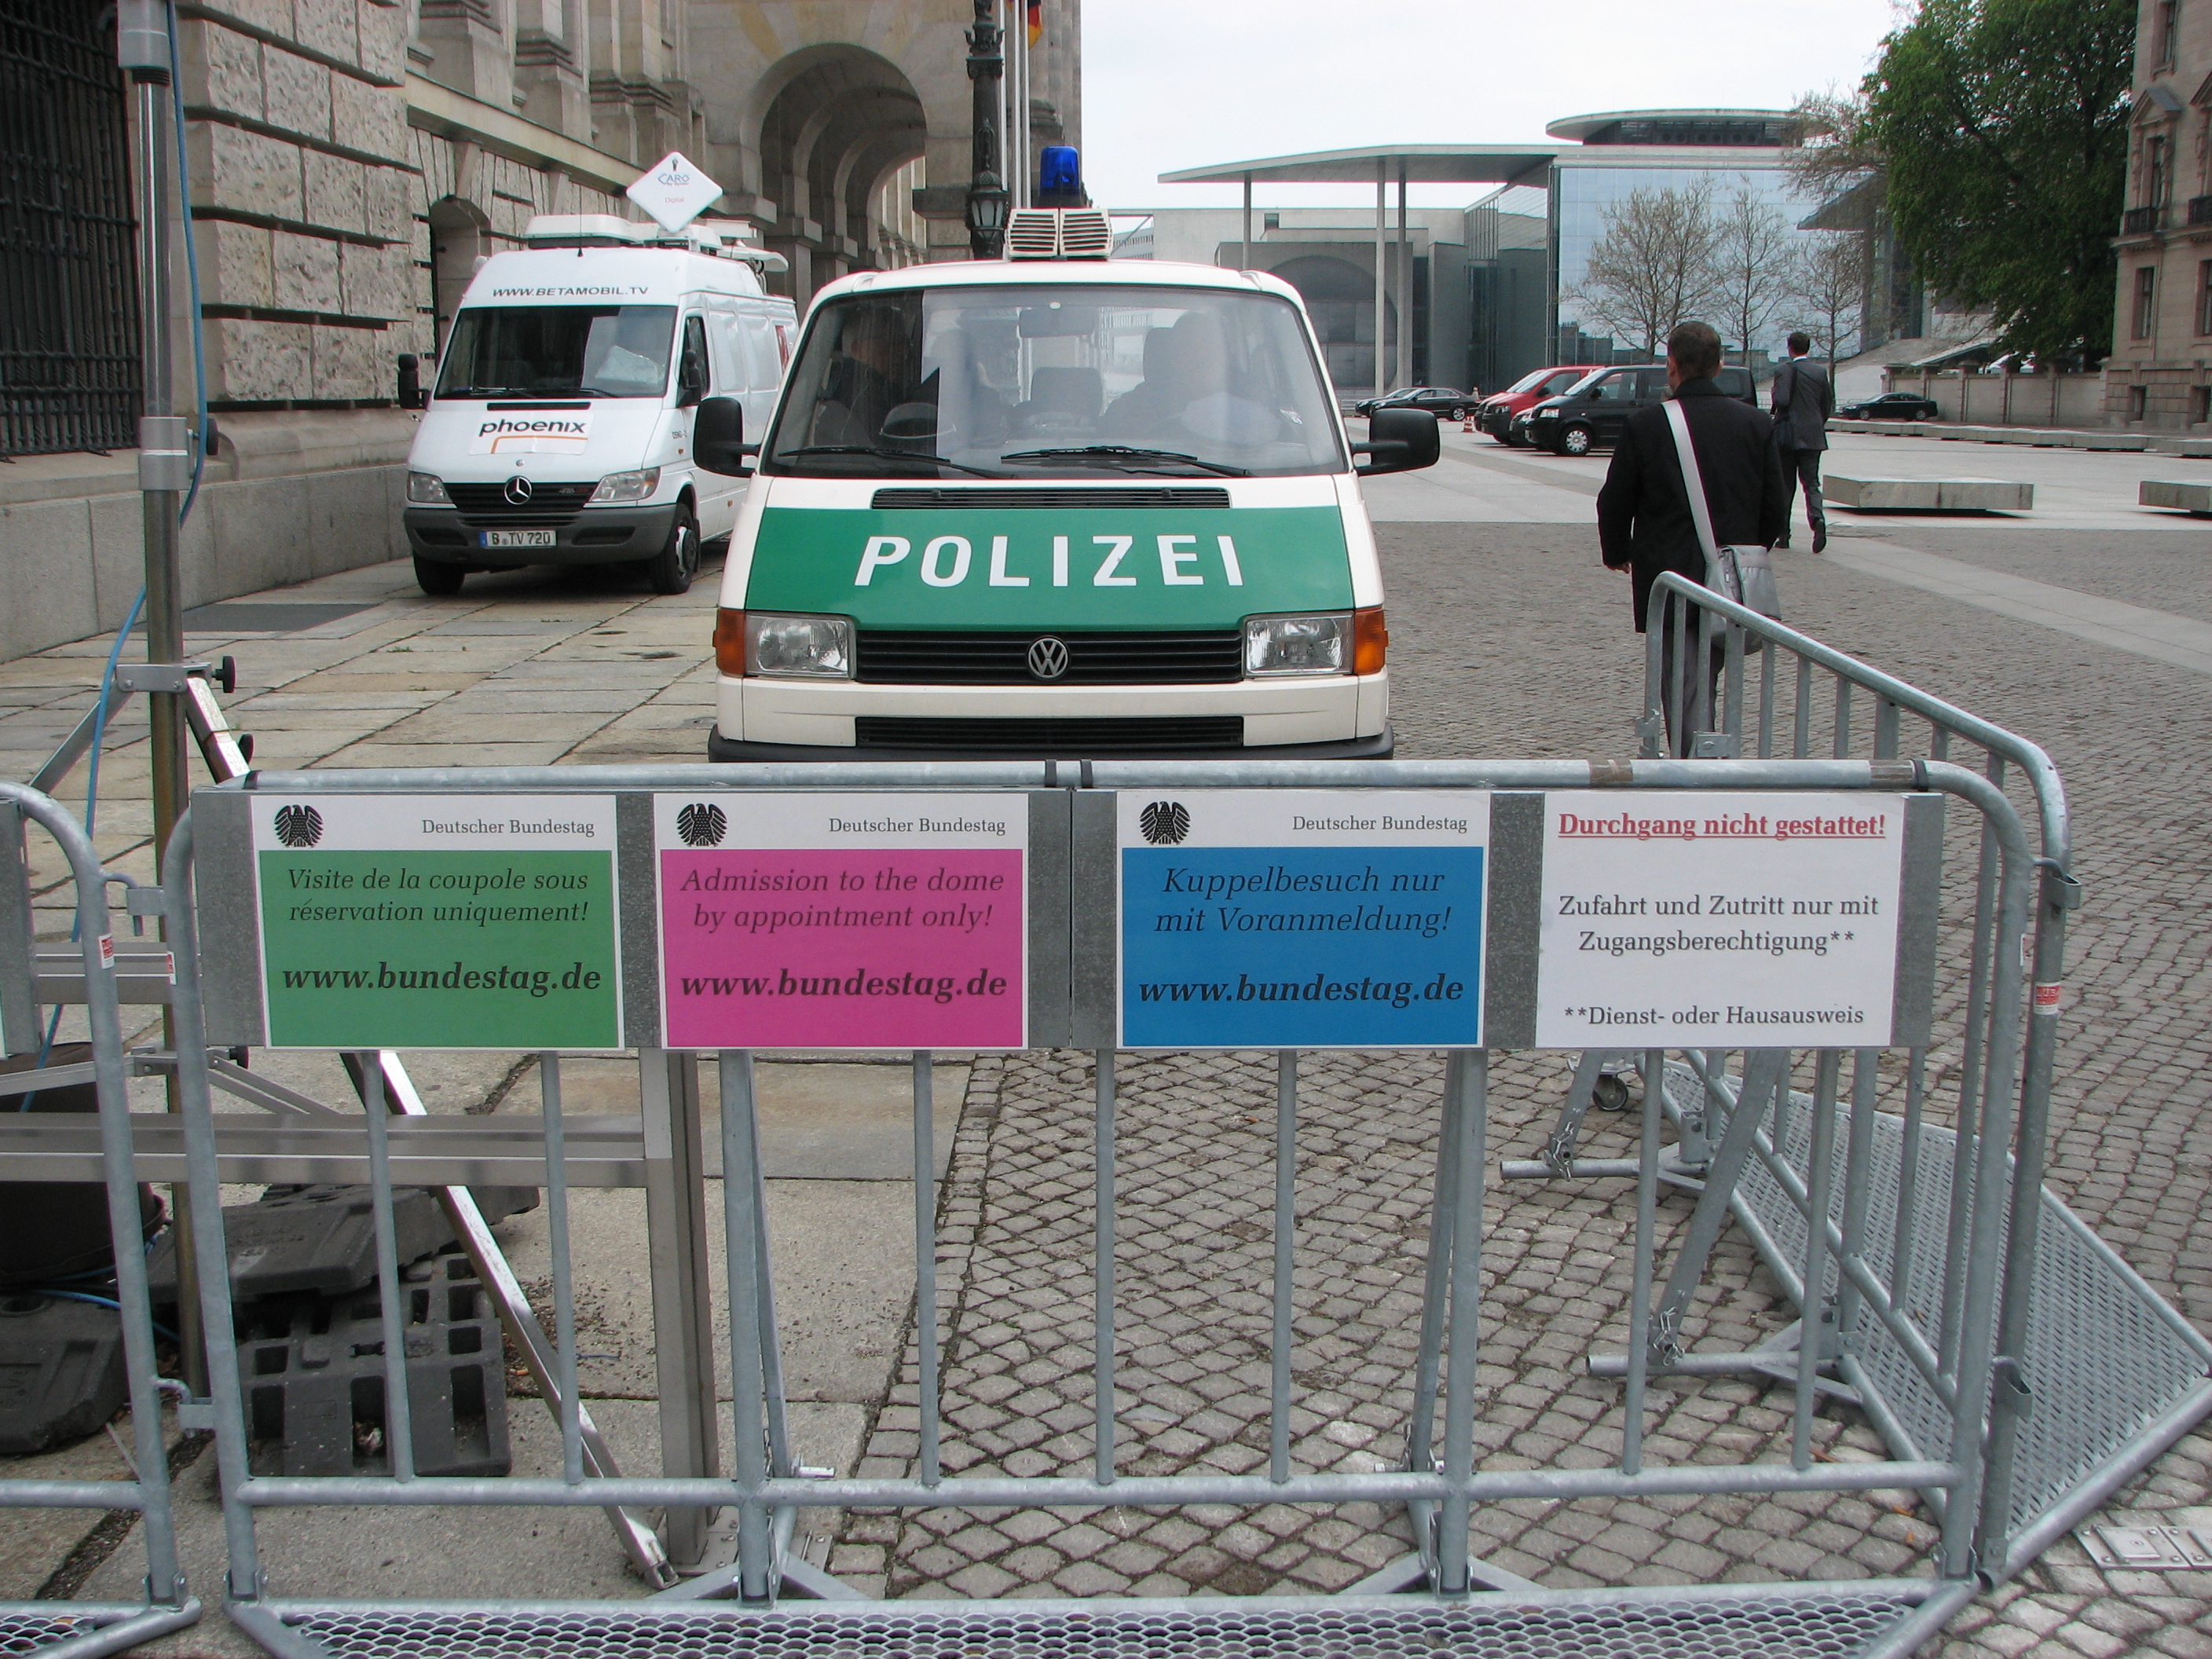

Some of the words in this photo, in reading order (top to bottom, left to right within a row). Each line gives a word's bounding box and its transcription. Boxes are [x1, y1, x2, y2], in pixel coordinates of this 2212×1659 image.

[493, 287, 650, 297] WWW.BETAMOBIL.TV
[478, 419, 587, 437] phoenix
[855, 535, 1244, 588] POLIZEI
[422, 819, 504, 834] Deutscher
[509, 819, 595, 837] Bundestag
[829, 818, 914, 833] Deutscher
[918, 817, 1006, 836] Bundestag
[1292, 815, 1376, 830] Deutscher
[1381, 815, 1468, 834] Bundestag
[1558, 812, 1697, 840] Durchgang
[1703, 812, 1768, 835] nicht
[1774, 814, 1886, 840] gestattet!
[287, 869, 354, 889] Visite
[362, 867, 391, 889] de
[399, 867, 421, 889] la
[429, 867, 526, 895] coupole
[533, 874, 588, 889] sous
[679, 867, 829, 891] Admission
[839, 870, 865, 892] to
[874, 866, 917, 892] the
[927, 867, 1004, 892] dome
[1162, 866, 1379, 900] Kuppelbesuch
[1390, 873, 1445, 892] nur
[289, 899, 423, 921] réservation
[433, 901, 589, 928] uniquement!
[693, 903, 727, 934] by
[734, 904, 913, 934] appointment
[921, 903, 993, 934] only!
[1558, 894, 1647, 916] Zufahrt
[1654, 894, 1701, 916] und
[1708, 895, 1785, 916] Zutritt
[1792, 899, 1834, 916] nur
[1839, 895, 1879, 916] mit
[1154, 907, 1206, 932] mit
[1218, 905, 1452, 939] Voranmeldung!
[283, 961, 601, 998] www.bundestag.de
[680, 968, 1007, 1004] www.bundestag.de
[1139, 973, 1463, 1009] www.bundestag.de
[1672, 1005, 1720, 1025] oder
[1725, 1004, 1865, 1024] Hausausweis
